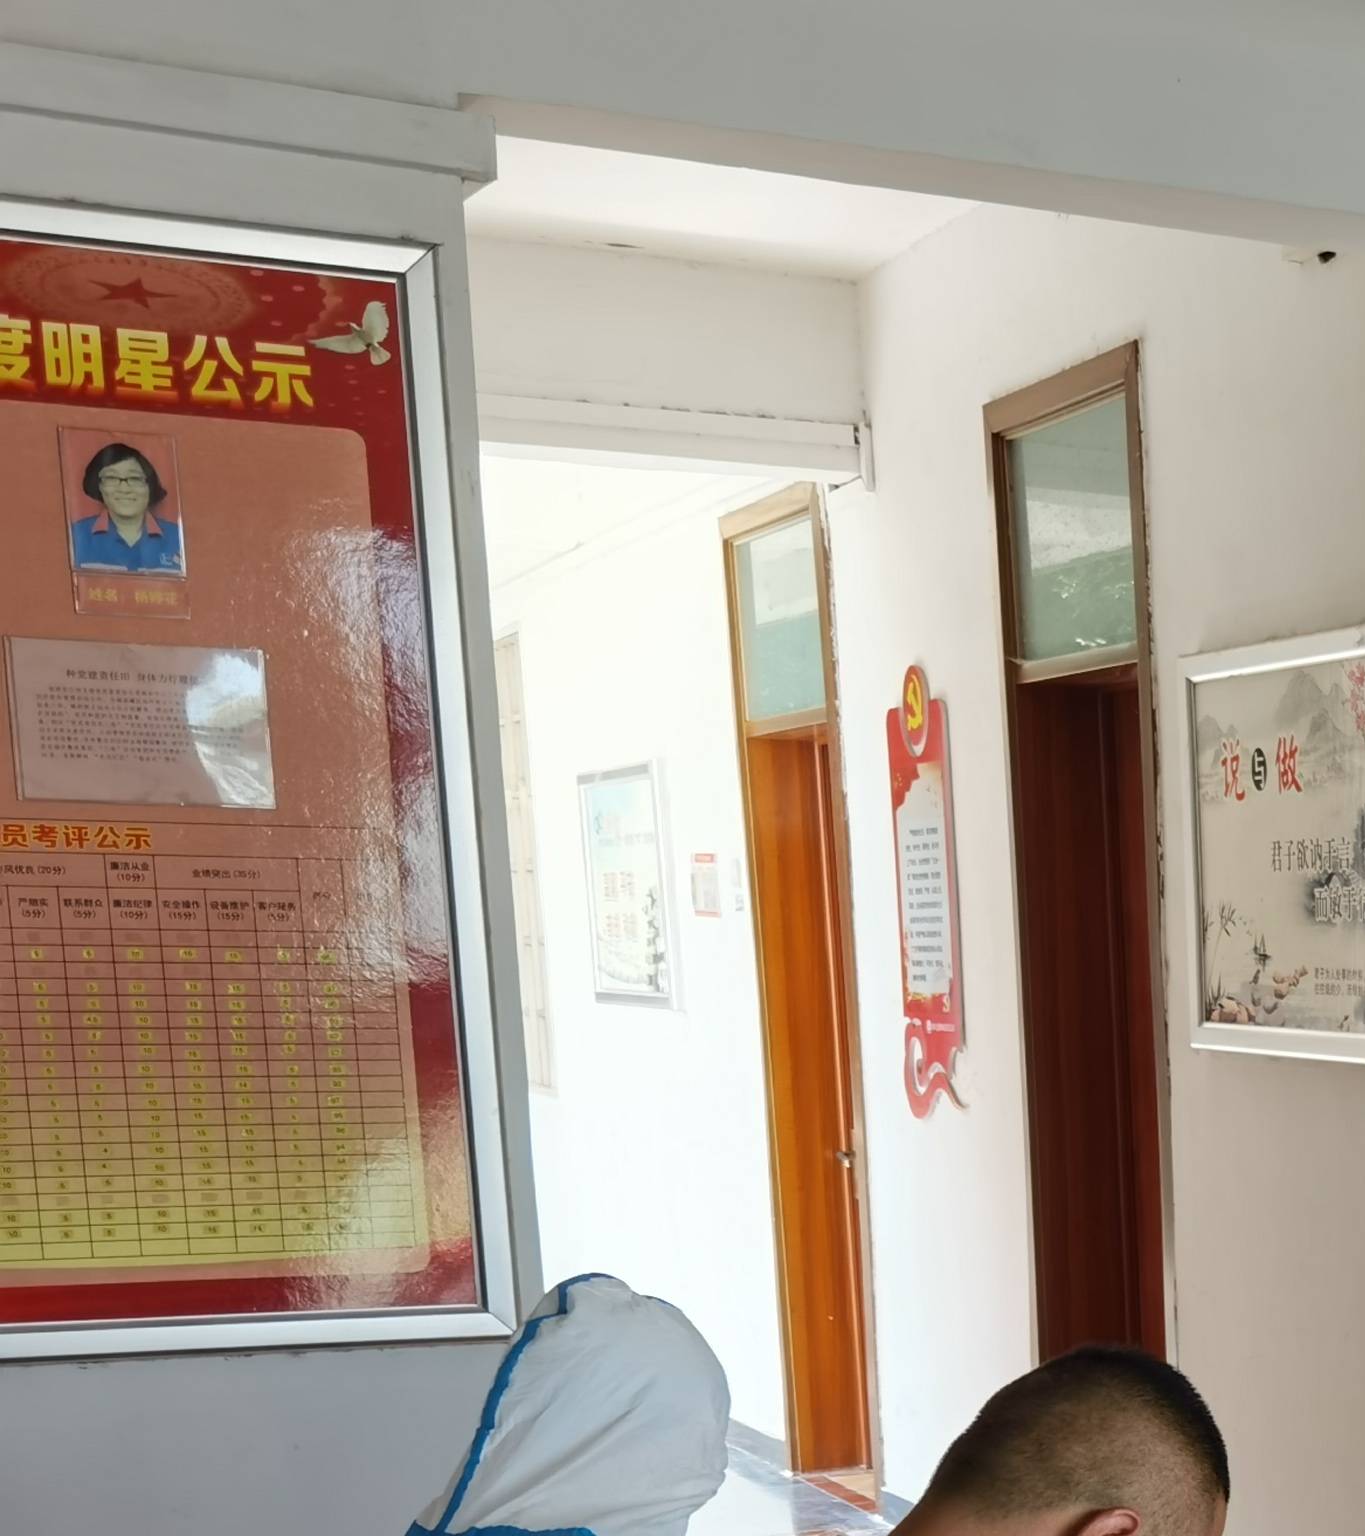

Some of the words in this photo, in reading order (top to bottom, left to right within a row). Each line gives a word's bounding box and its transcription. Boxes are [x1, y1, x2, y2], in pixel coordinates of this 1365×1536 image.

[1221, 734, 1303, 802] 说与做
[1, 823, 152, 851] 员考评公示
